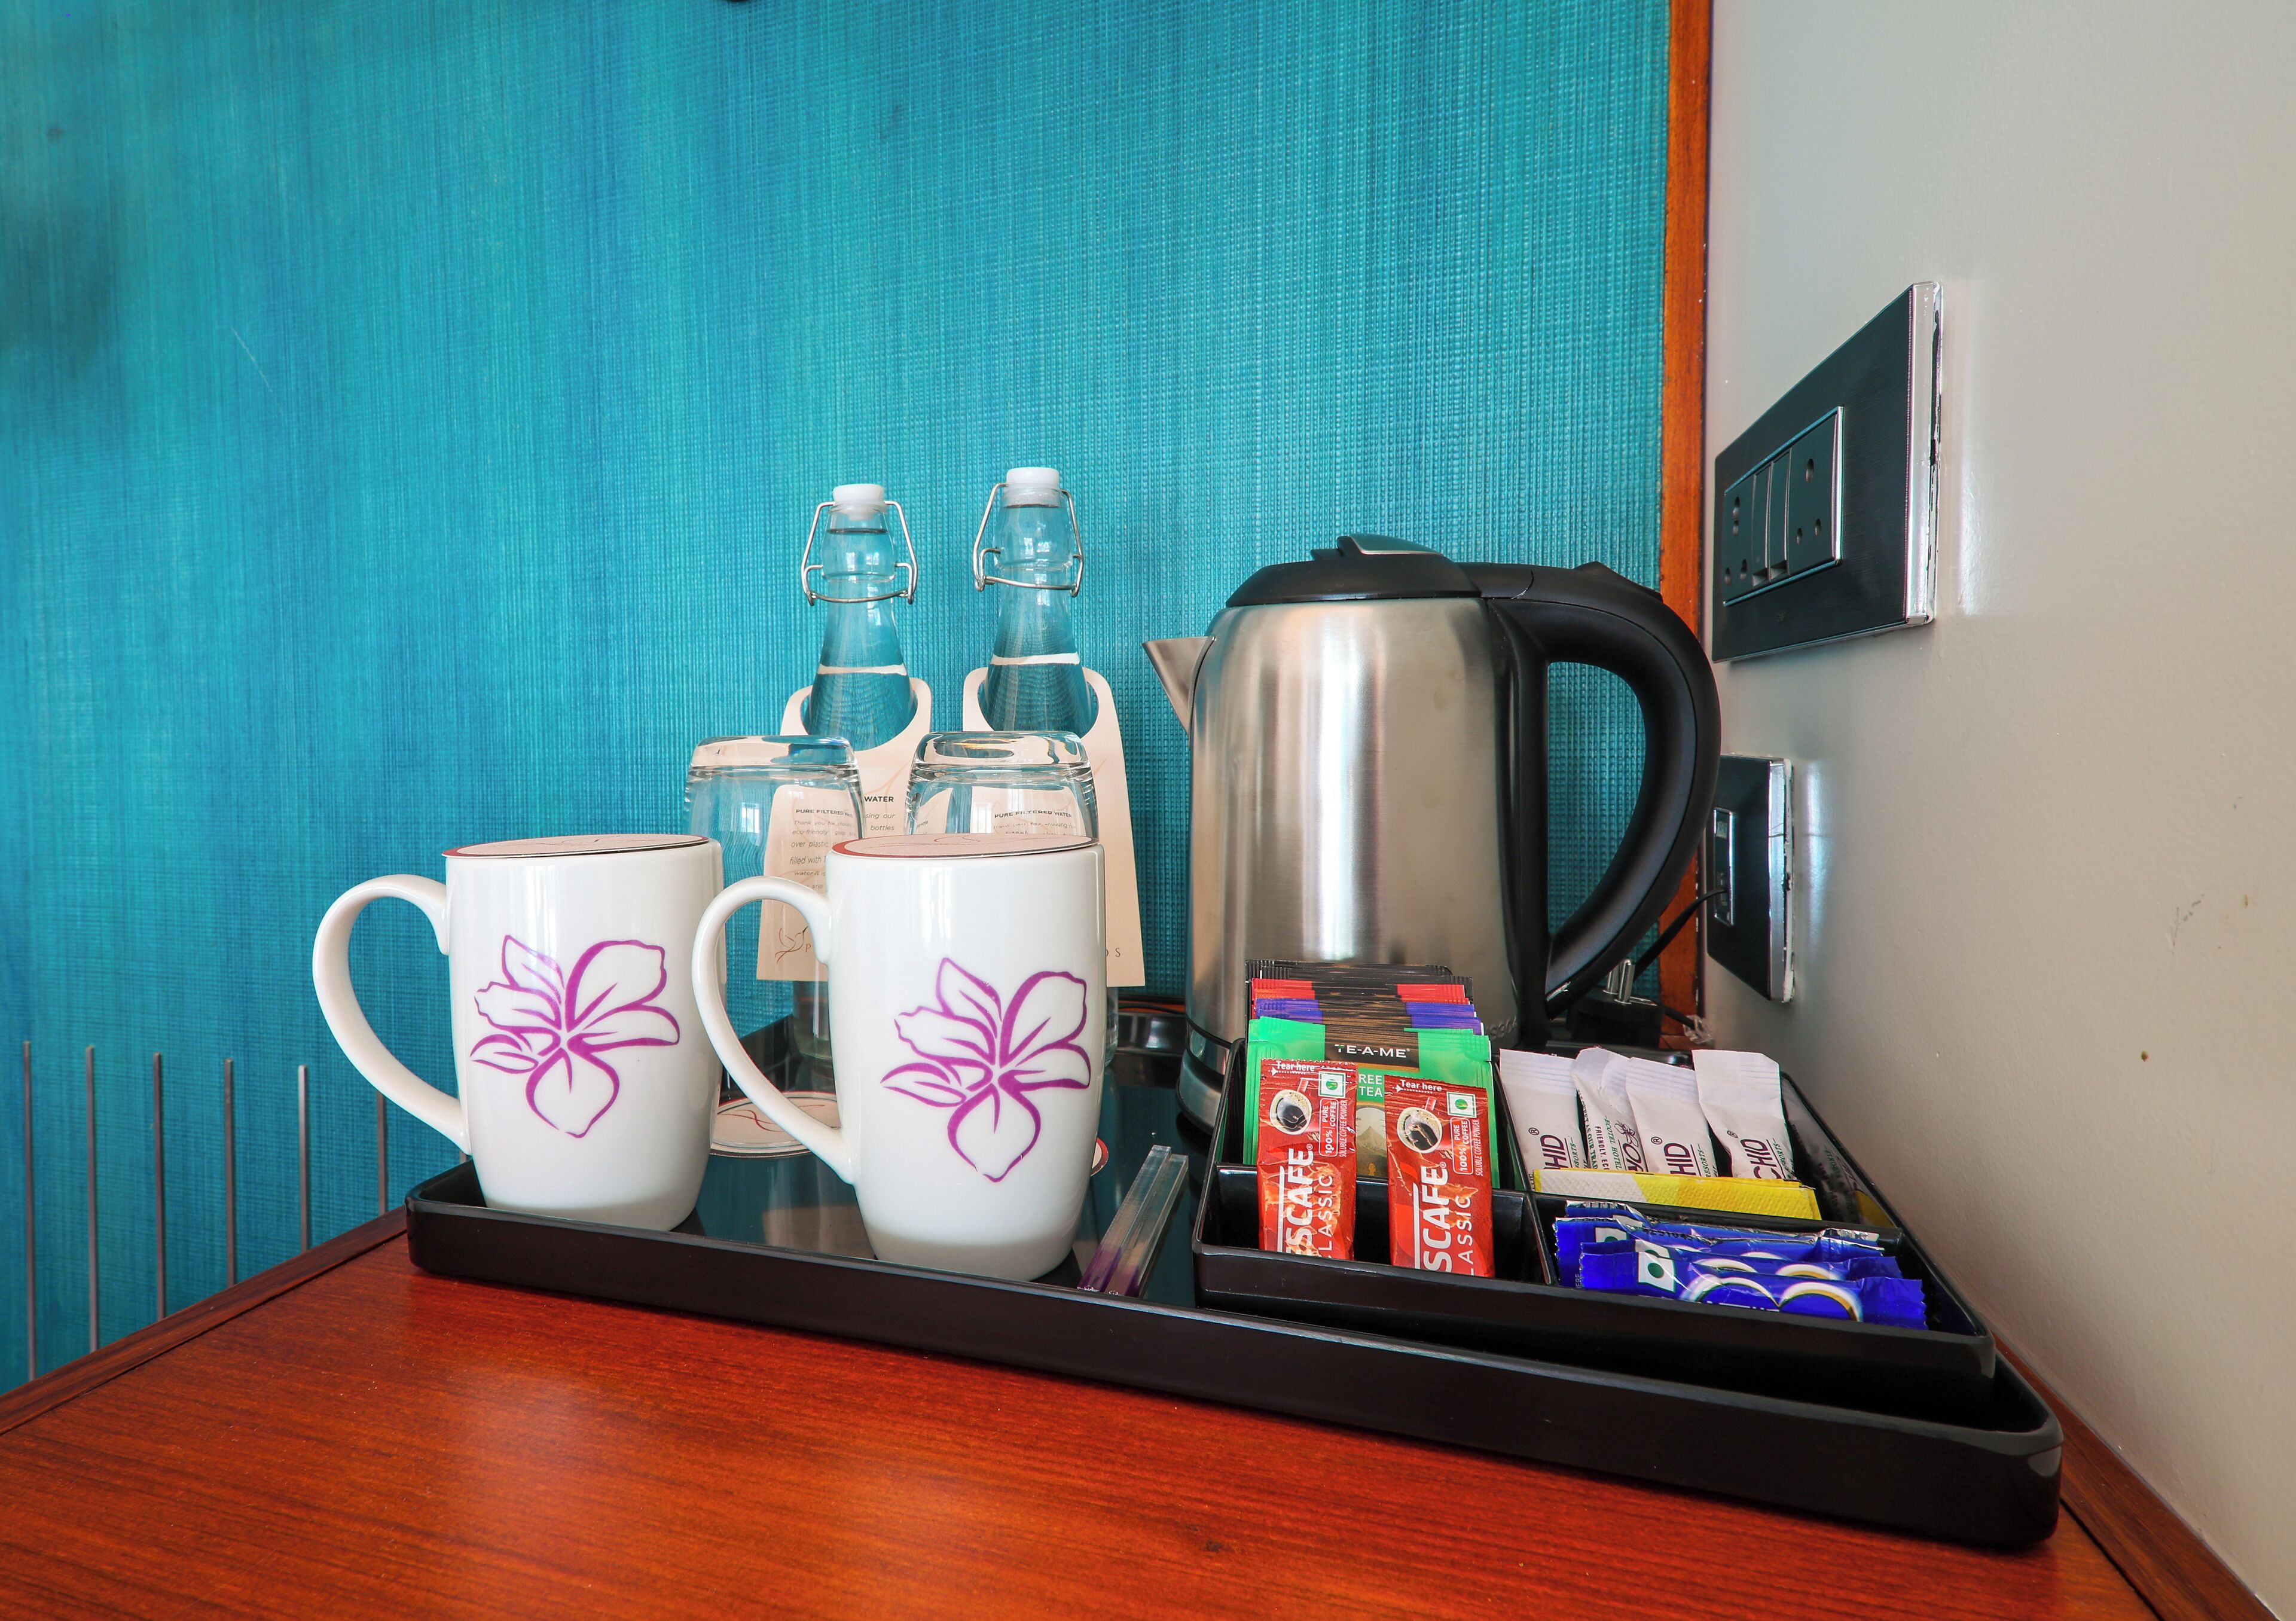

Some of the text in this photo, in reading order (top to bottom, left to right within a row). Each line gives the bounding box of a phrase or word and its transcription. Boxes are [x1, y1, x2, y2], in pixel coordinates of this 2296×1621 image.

[789, 856, 806, 865] filled
[1276, 1061, 1315, 1071] Tear here
[1359, 1086, 1383, 1097] TEA
[1400, 1079, 1443, 1092] Tear here
[1325, 1129, 1333, 1154] 100%
[1461, 1121, 1469, 1145] COFFEE
[1459, 1147, 1468, 1172] 100%
[1472, 1119, 1483, 1176] SOLUBLE COFFEE POWDER
[1540, 1135, 1568, 1169] HID
[1663, 1143, 1696, 1176] HID
[1318, 1175, 1334, 1254] LASSIC
